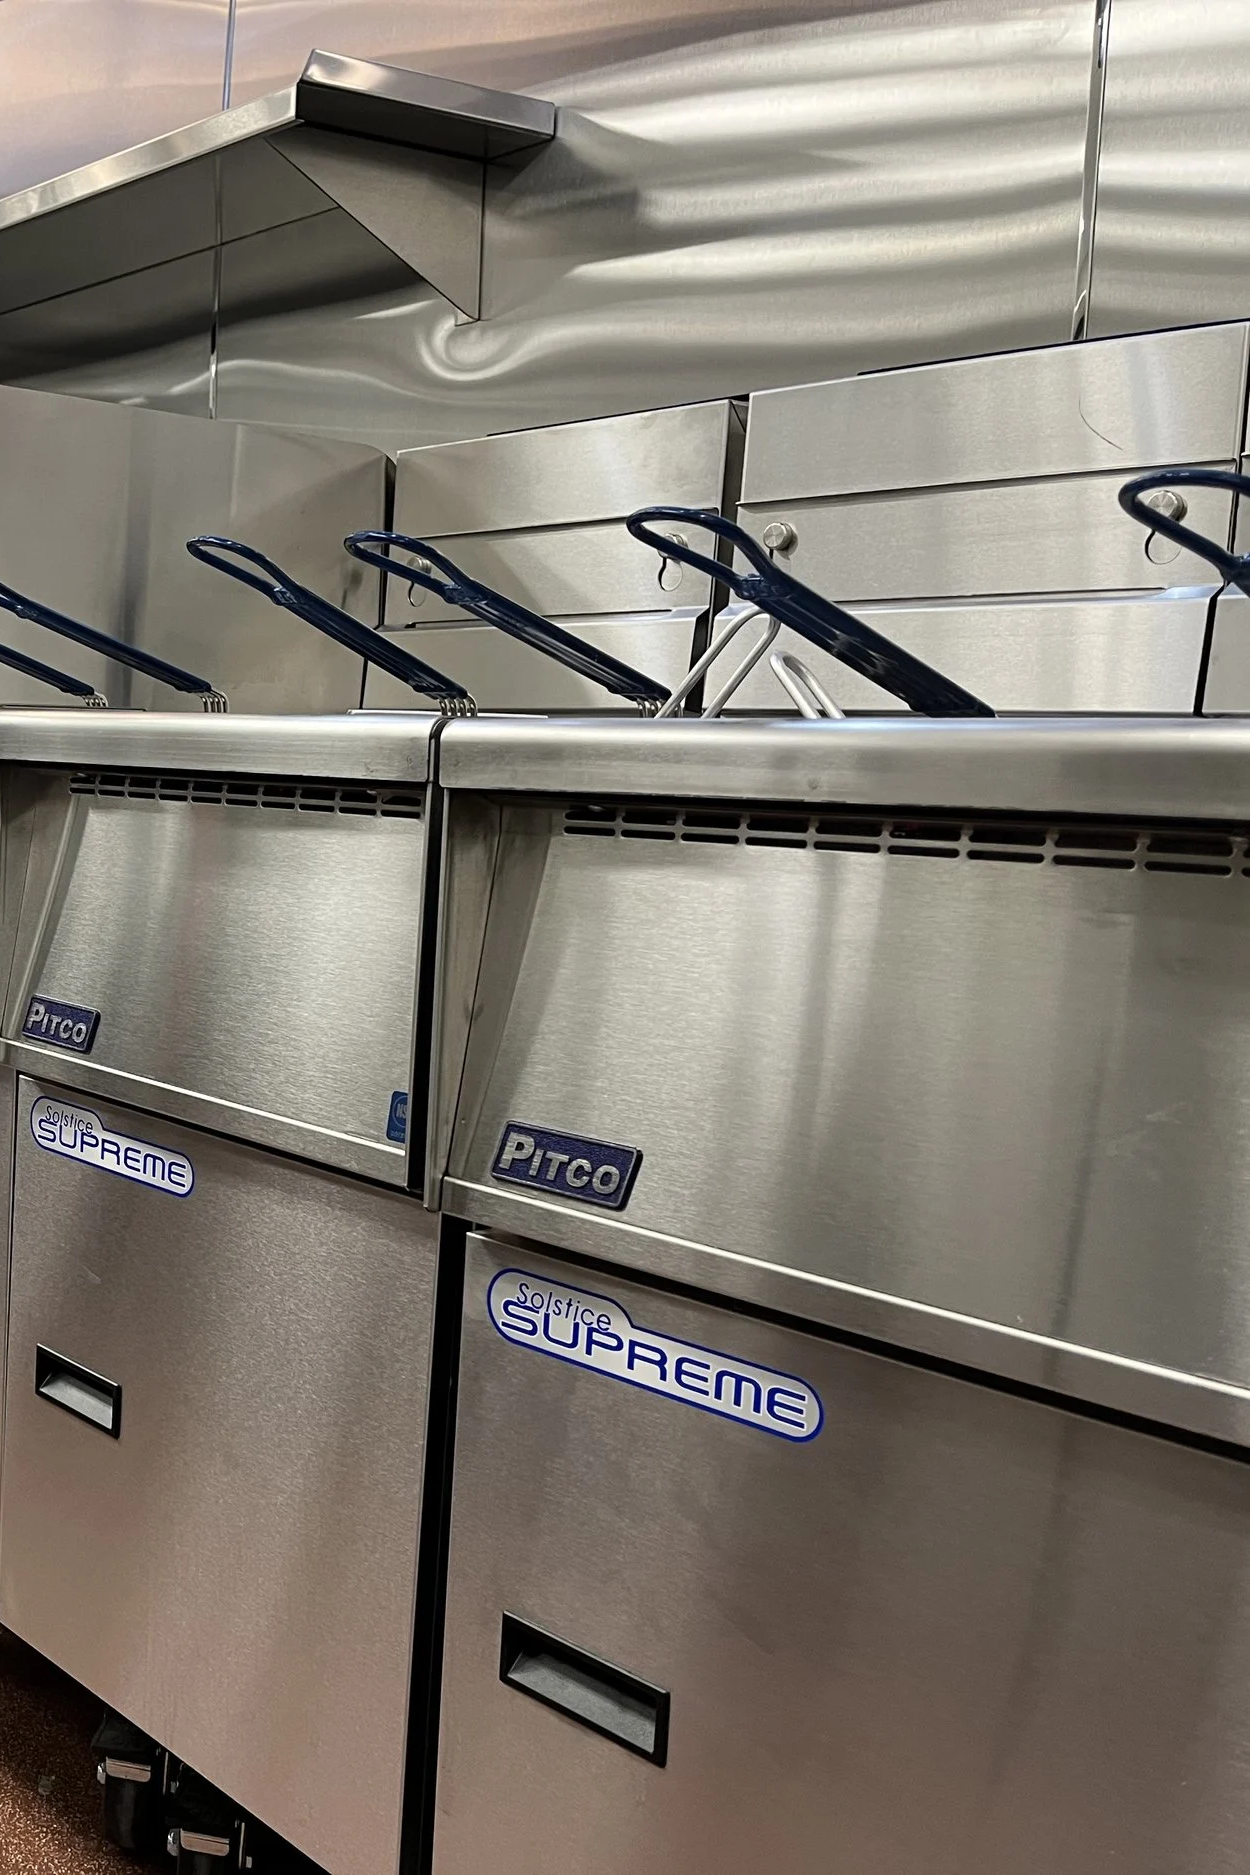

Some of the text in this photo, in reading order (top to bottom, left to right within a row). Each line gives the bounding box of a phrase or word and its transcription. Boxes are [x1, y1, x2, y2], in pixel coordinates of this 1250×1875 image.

[27, 1002, 87, 1043] PITCO
[45, 1105, 94, 1135] Solstice
[37, 1118, 186, 1188] SUPREME
[499, 1131, 620, 1195] PITCO
[516, 1282, 612, 1332] Solstice
[501, 1299, 806, 1430] SUPREME
